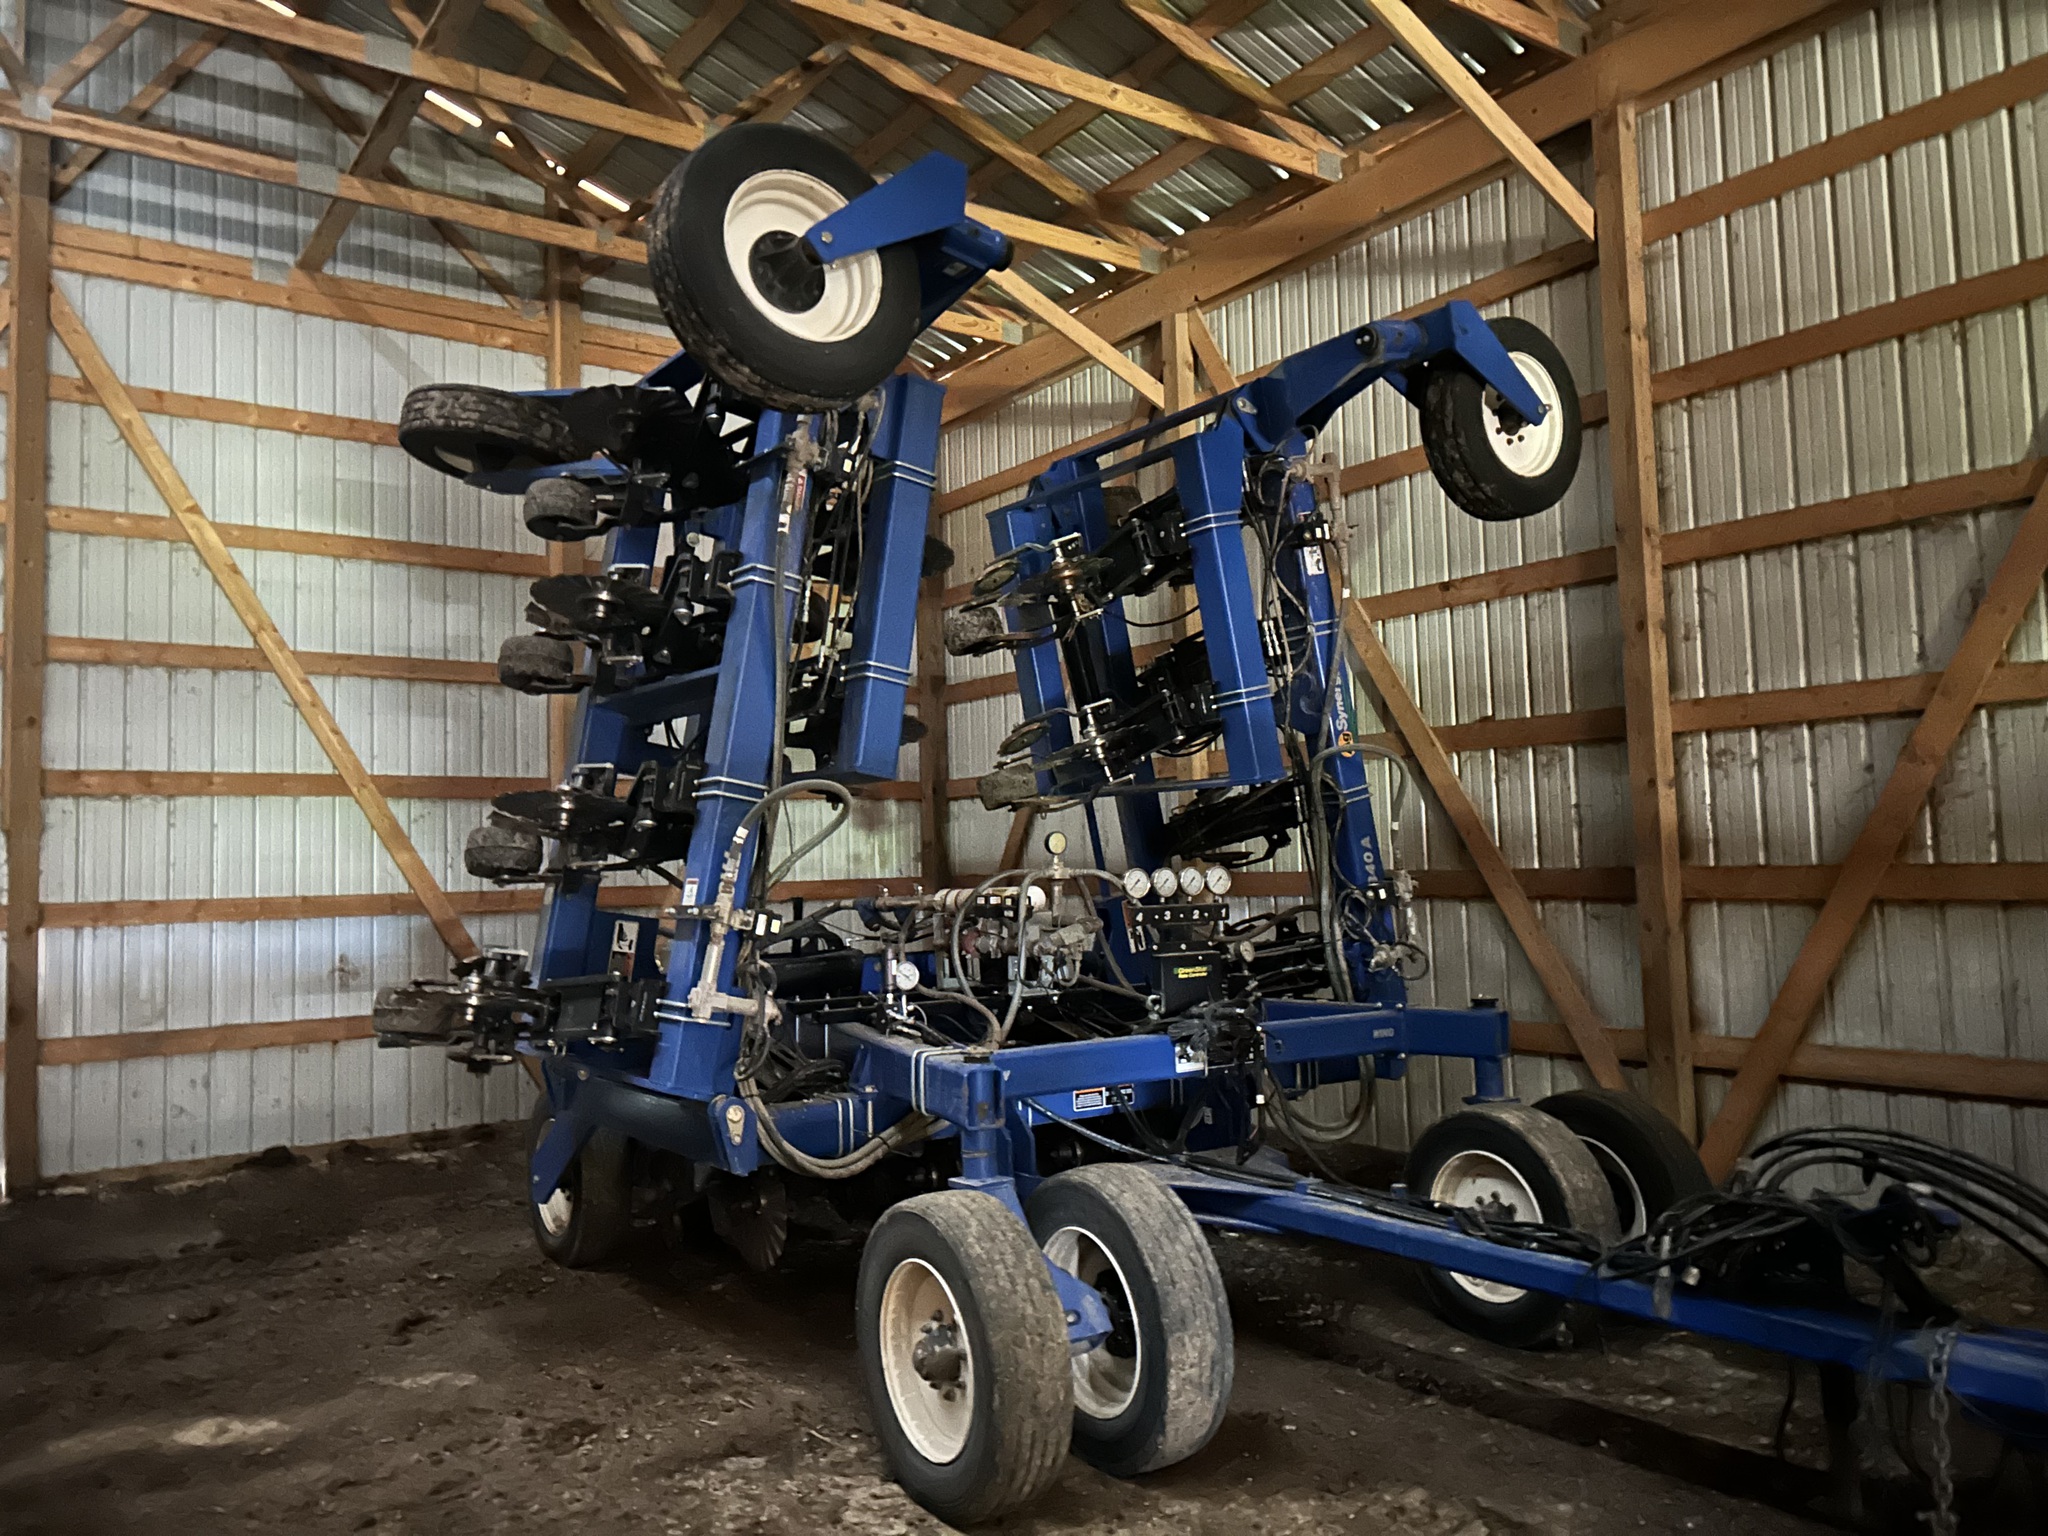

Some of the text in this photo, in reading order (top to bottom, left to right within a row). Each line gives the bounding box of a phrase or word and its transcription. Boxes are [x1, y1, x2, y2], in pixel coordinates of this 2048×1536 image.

[1135, 907, 1226, 922] 4 3 2 1
